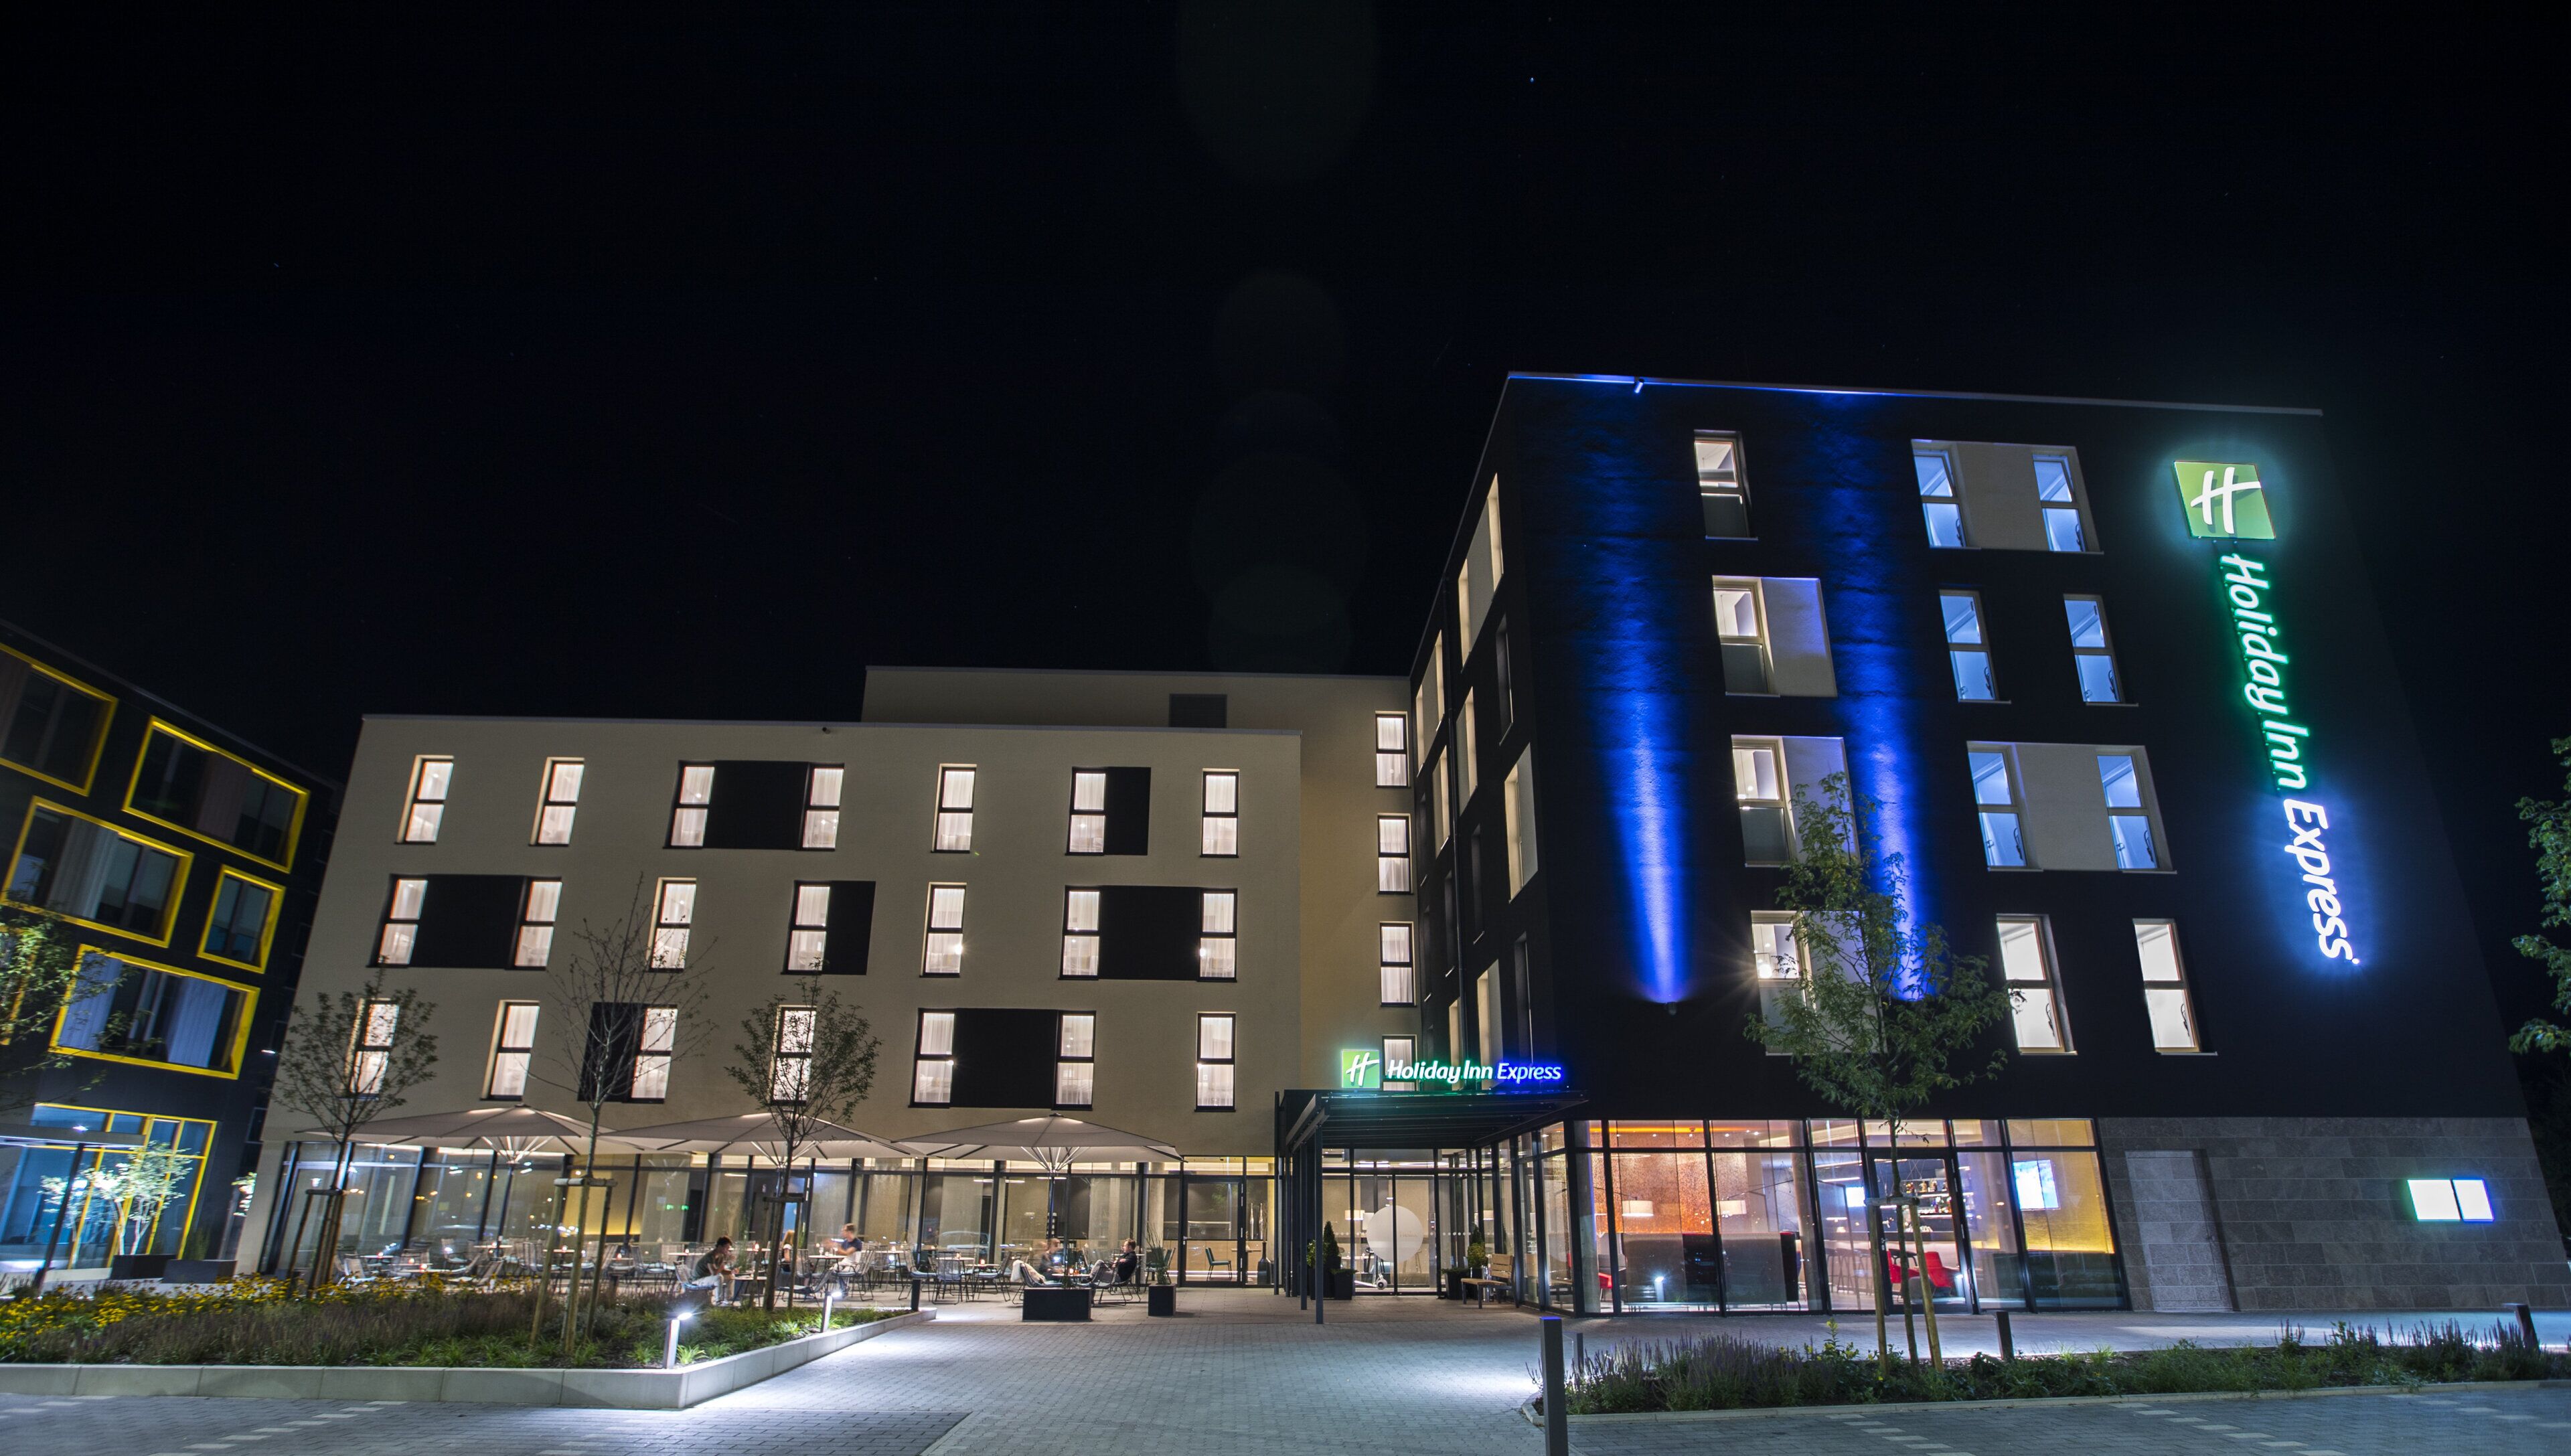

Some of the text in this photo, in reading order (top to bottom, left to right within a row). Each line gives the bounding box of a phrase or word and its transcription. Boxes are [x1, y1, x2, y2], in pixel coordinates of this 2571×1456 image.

[2222, 554, 2354, 961] Holiday Inn Express
[1387, 1059, 1561, 1084] Holiday Inn Express
